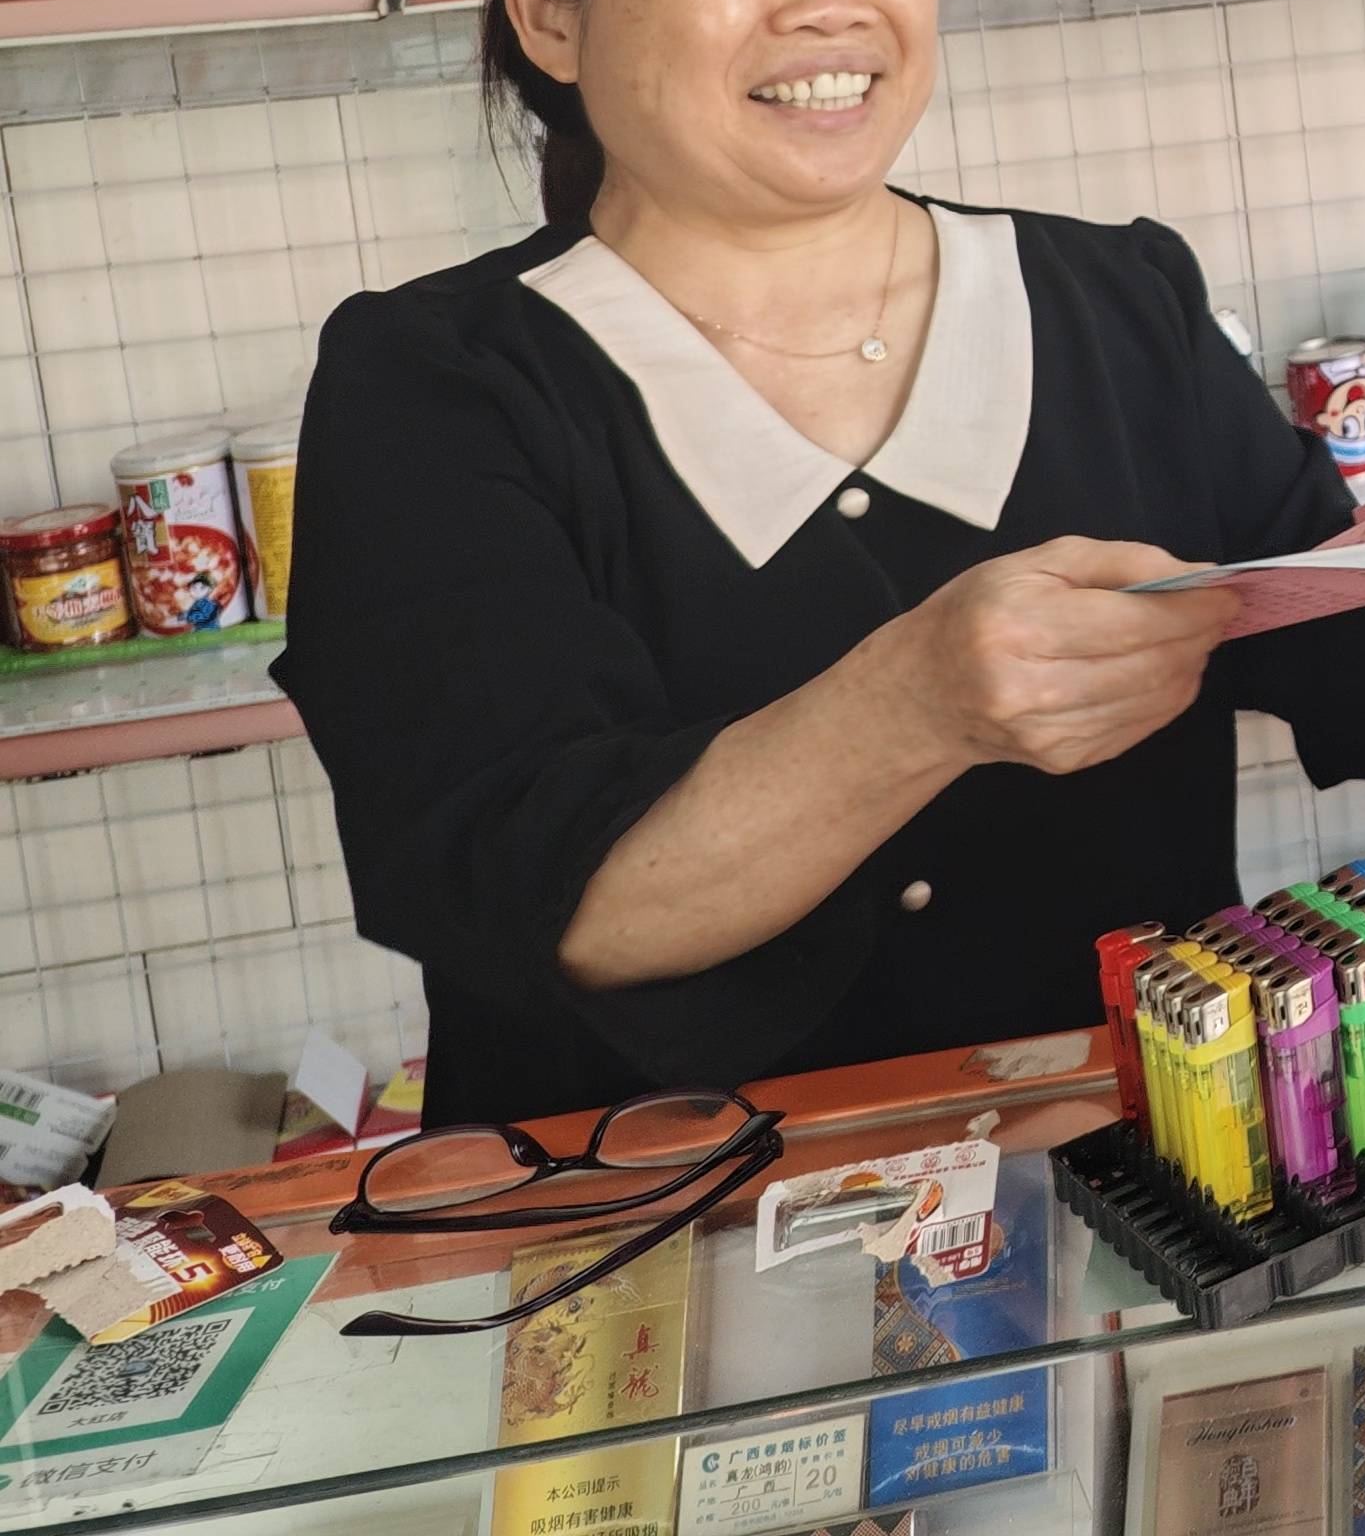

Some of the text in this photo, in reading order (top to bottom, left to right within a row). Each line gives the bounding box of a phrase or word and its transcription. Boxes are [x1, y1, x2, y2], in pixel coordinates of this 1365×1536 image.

[893, 1391, 1025, 1436] 尽早戒烟有益健康
[728, 1428, 848, 1465] 广西卷烟标价签
[915, 1428, 1002, 1461] 戒烟可减少
[20, 1449, 157, 1489] 微信支付
[805, 1464, 838, 1491] 20
[905, 1445, 1012, 1482] 对健康的危害
[546, 1474, 621, 1503] 本公司提示
[530, 1501, 634, 1535] 吸烟有害健康
[731, 1497, 762, 1516] 200
